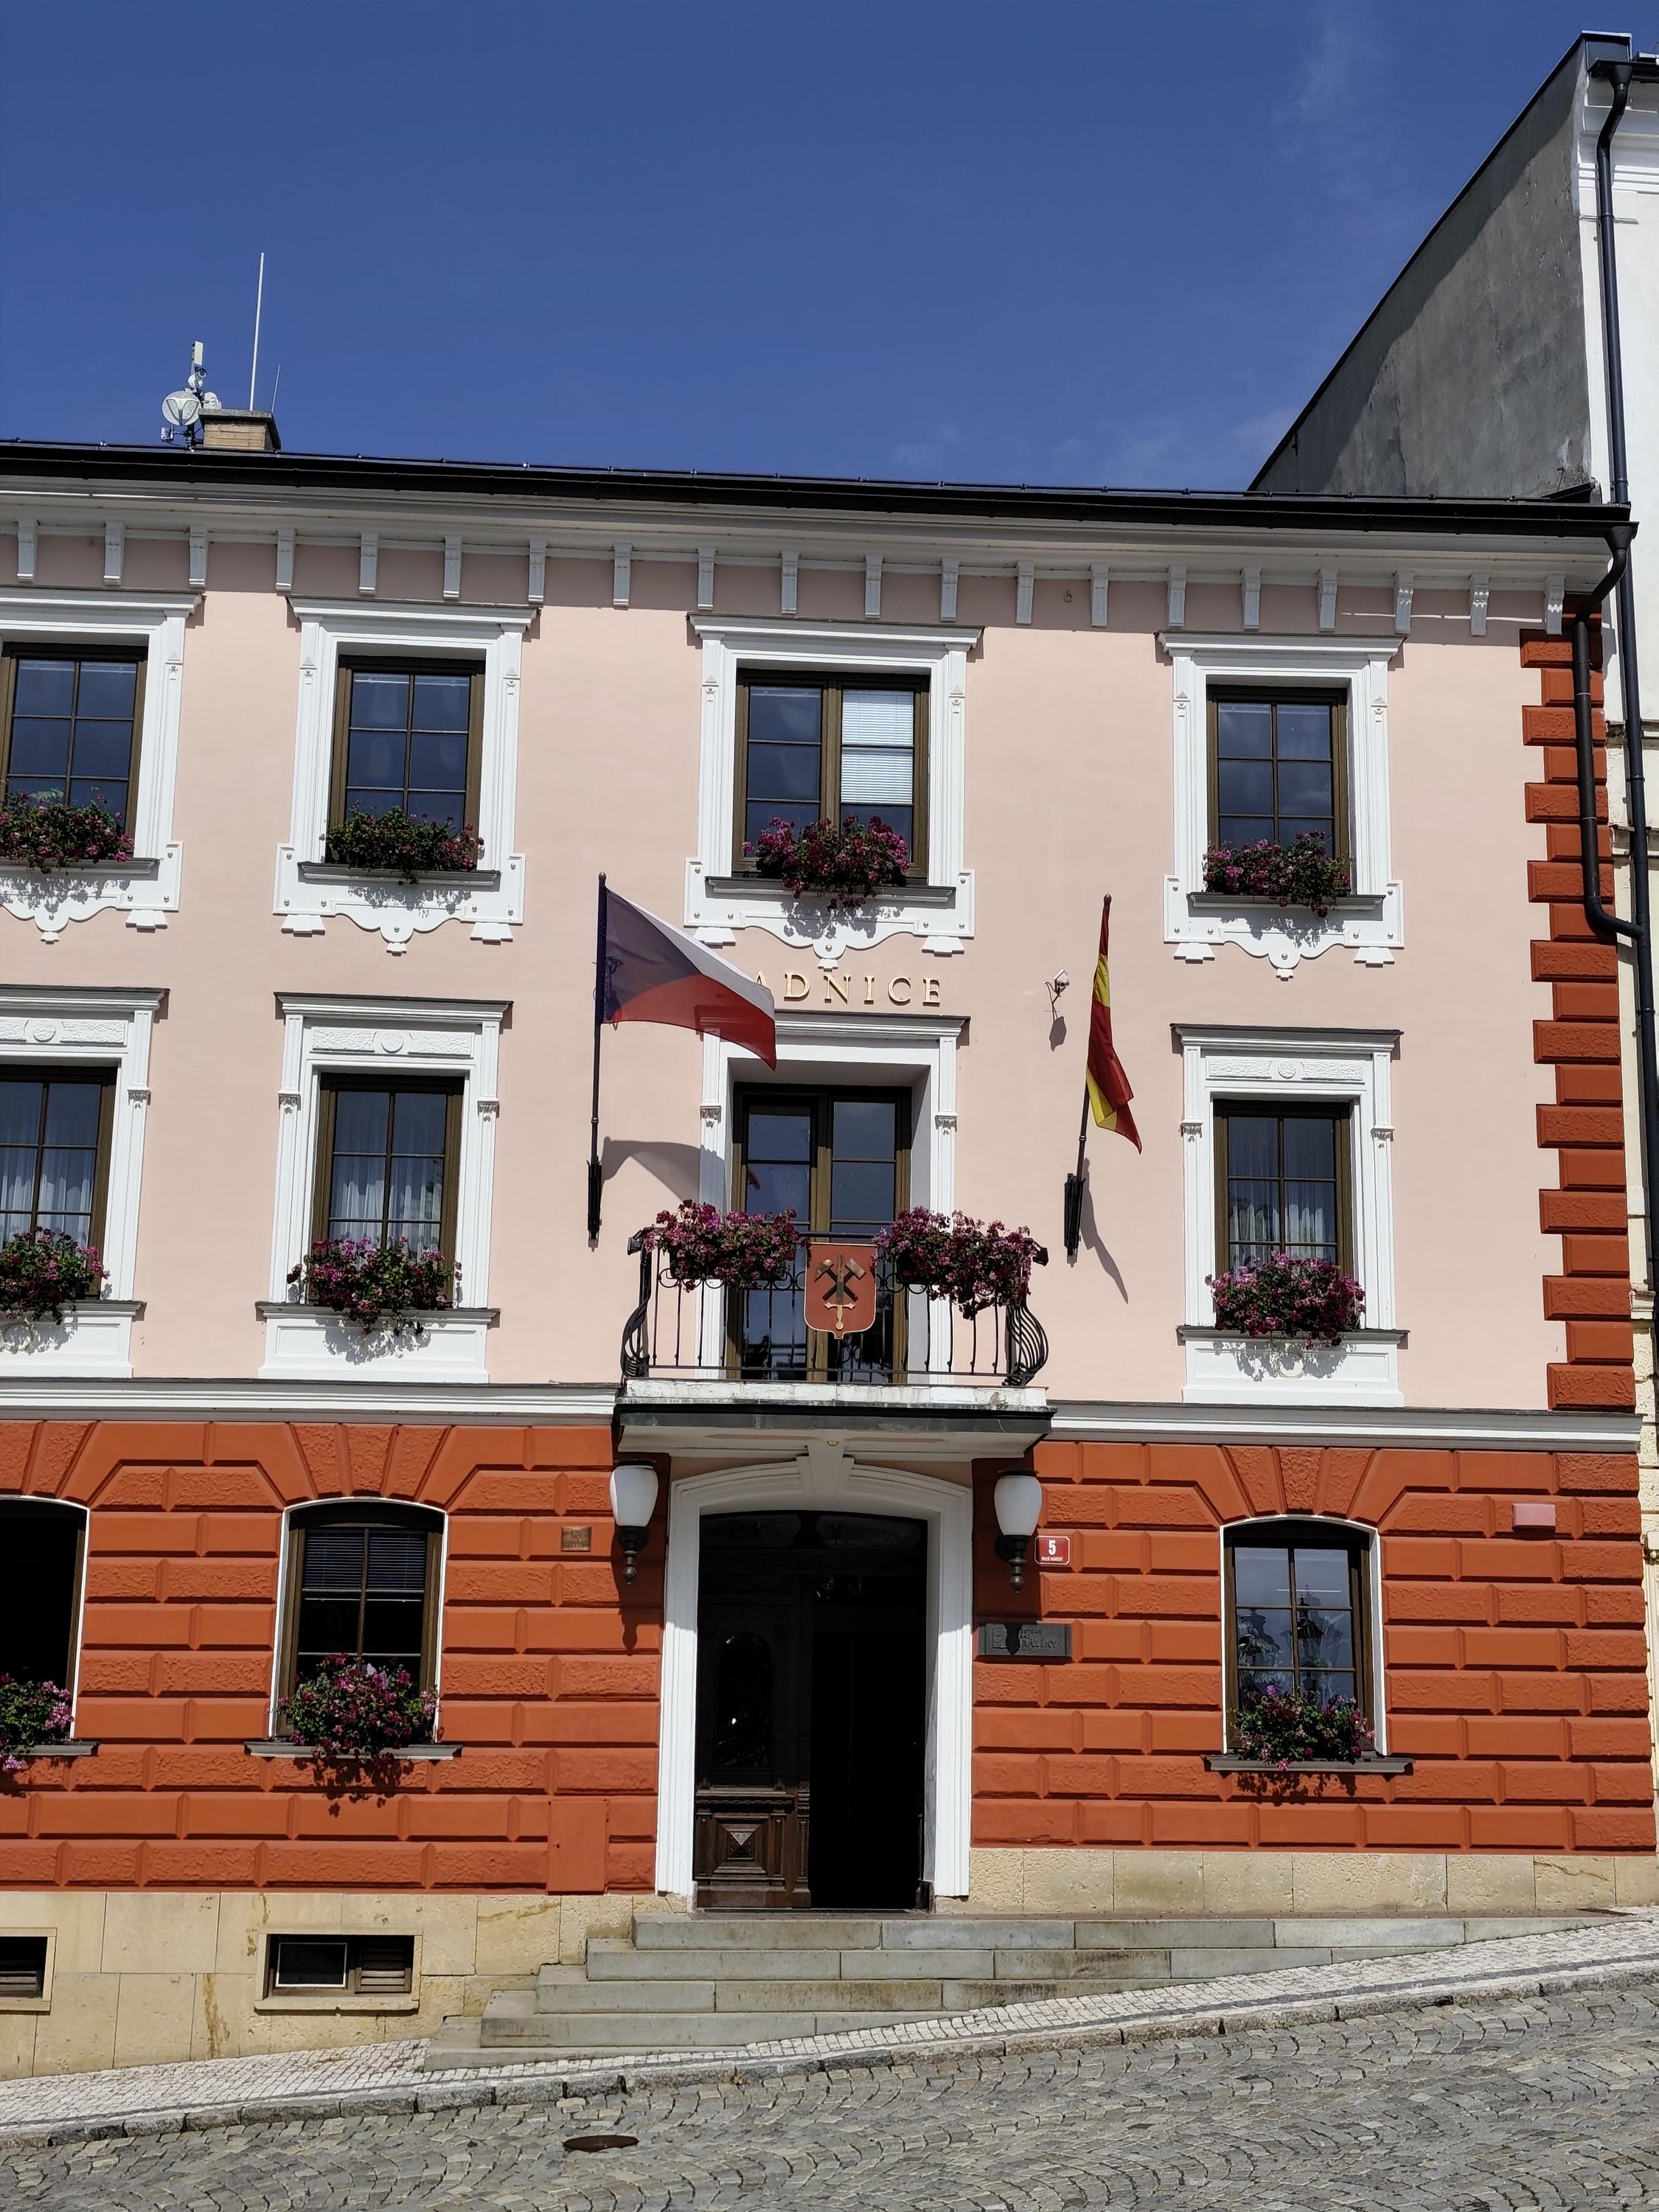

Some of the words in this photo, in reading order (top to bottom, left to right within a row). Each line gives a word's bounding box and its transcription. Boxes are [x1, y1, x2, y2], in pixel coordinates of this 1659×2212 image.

[754, 971, 941, 1006] ADNICE
[1048, 1540, 1057, 1556] 5
[1021, 1638, 1057, 1649] RÁLÍKY
